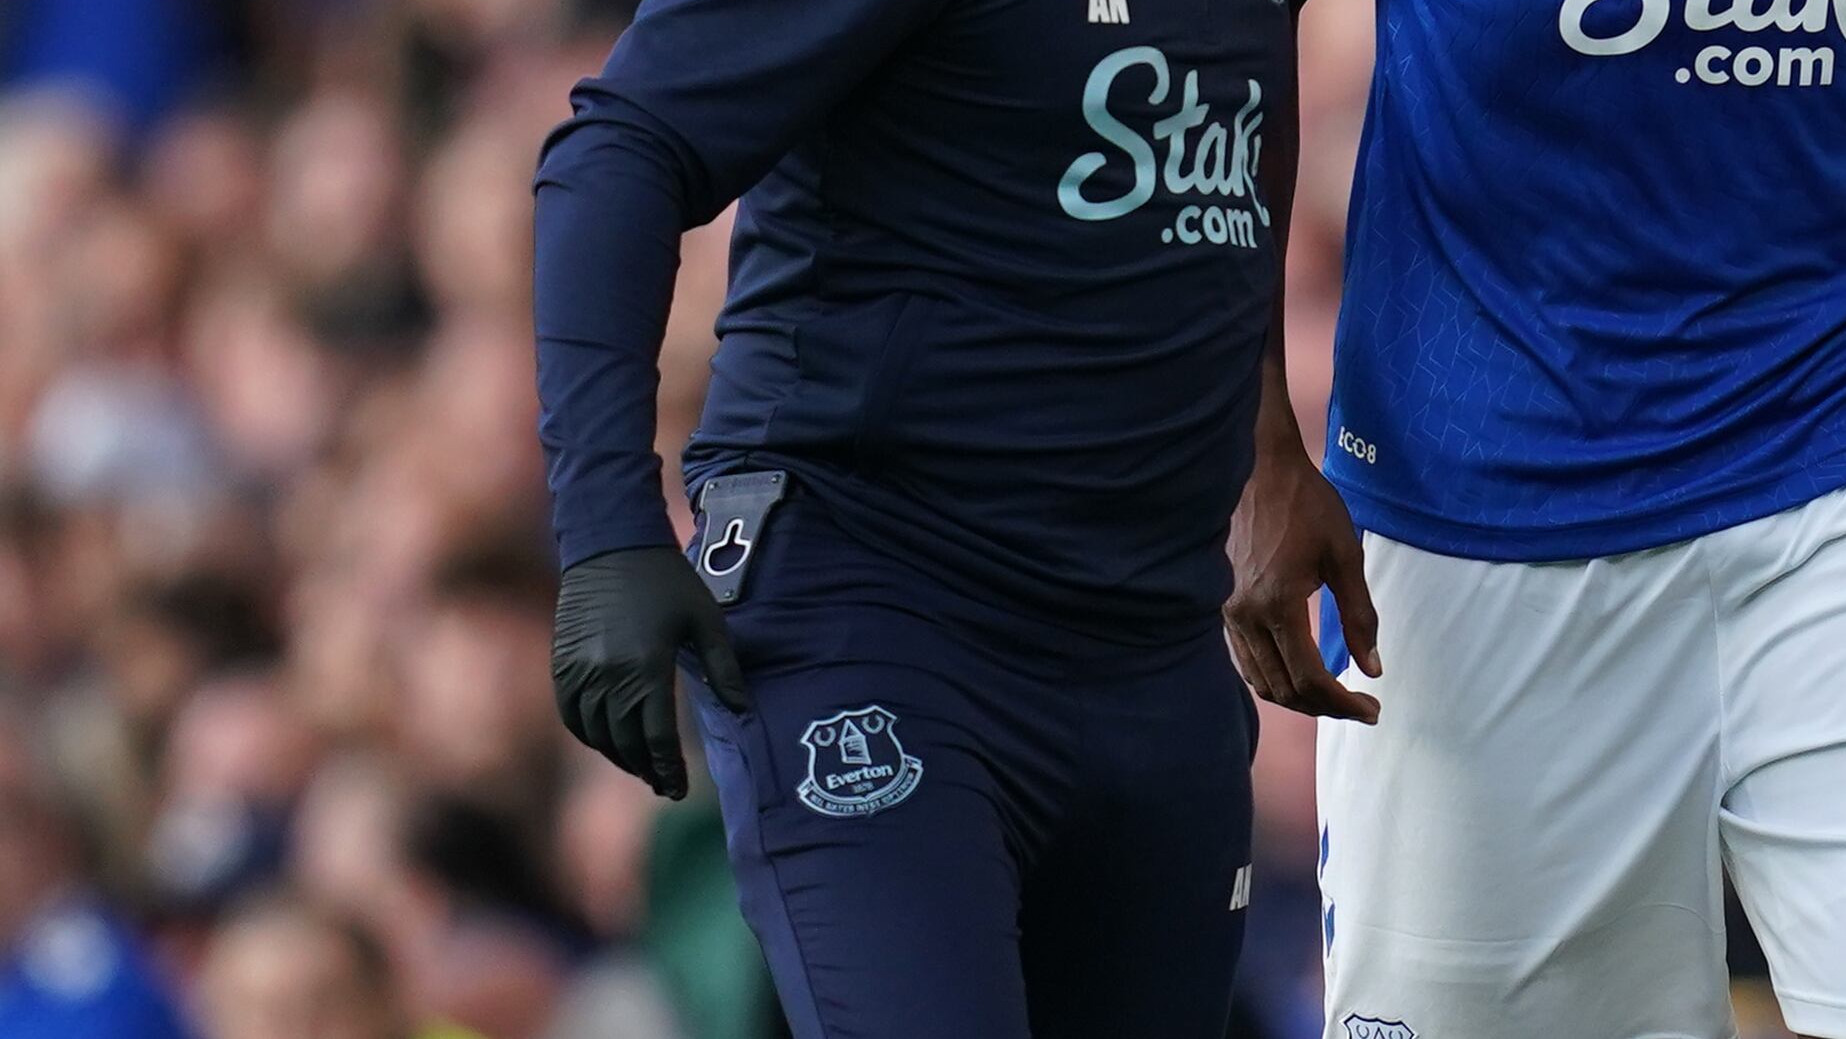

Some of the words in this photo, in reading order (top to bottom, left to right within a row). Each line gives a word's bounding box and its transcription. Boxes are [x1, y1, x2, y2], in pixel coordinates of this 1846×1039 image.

[1675, 45, 1835, 87] .com
[1160, 205, 1258, 249] .com
[825, 764, 895, 790] Everton
